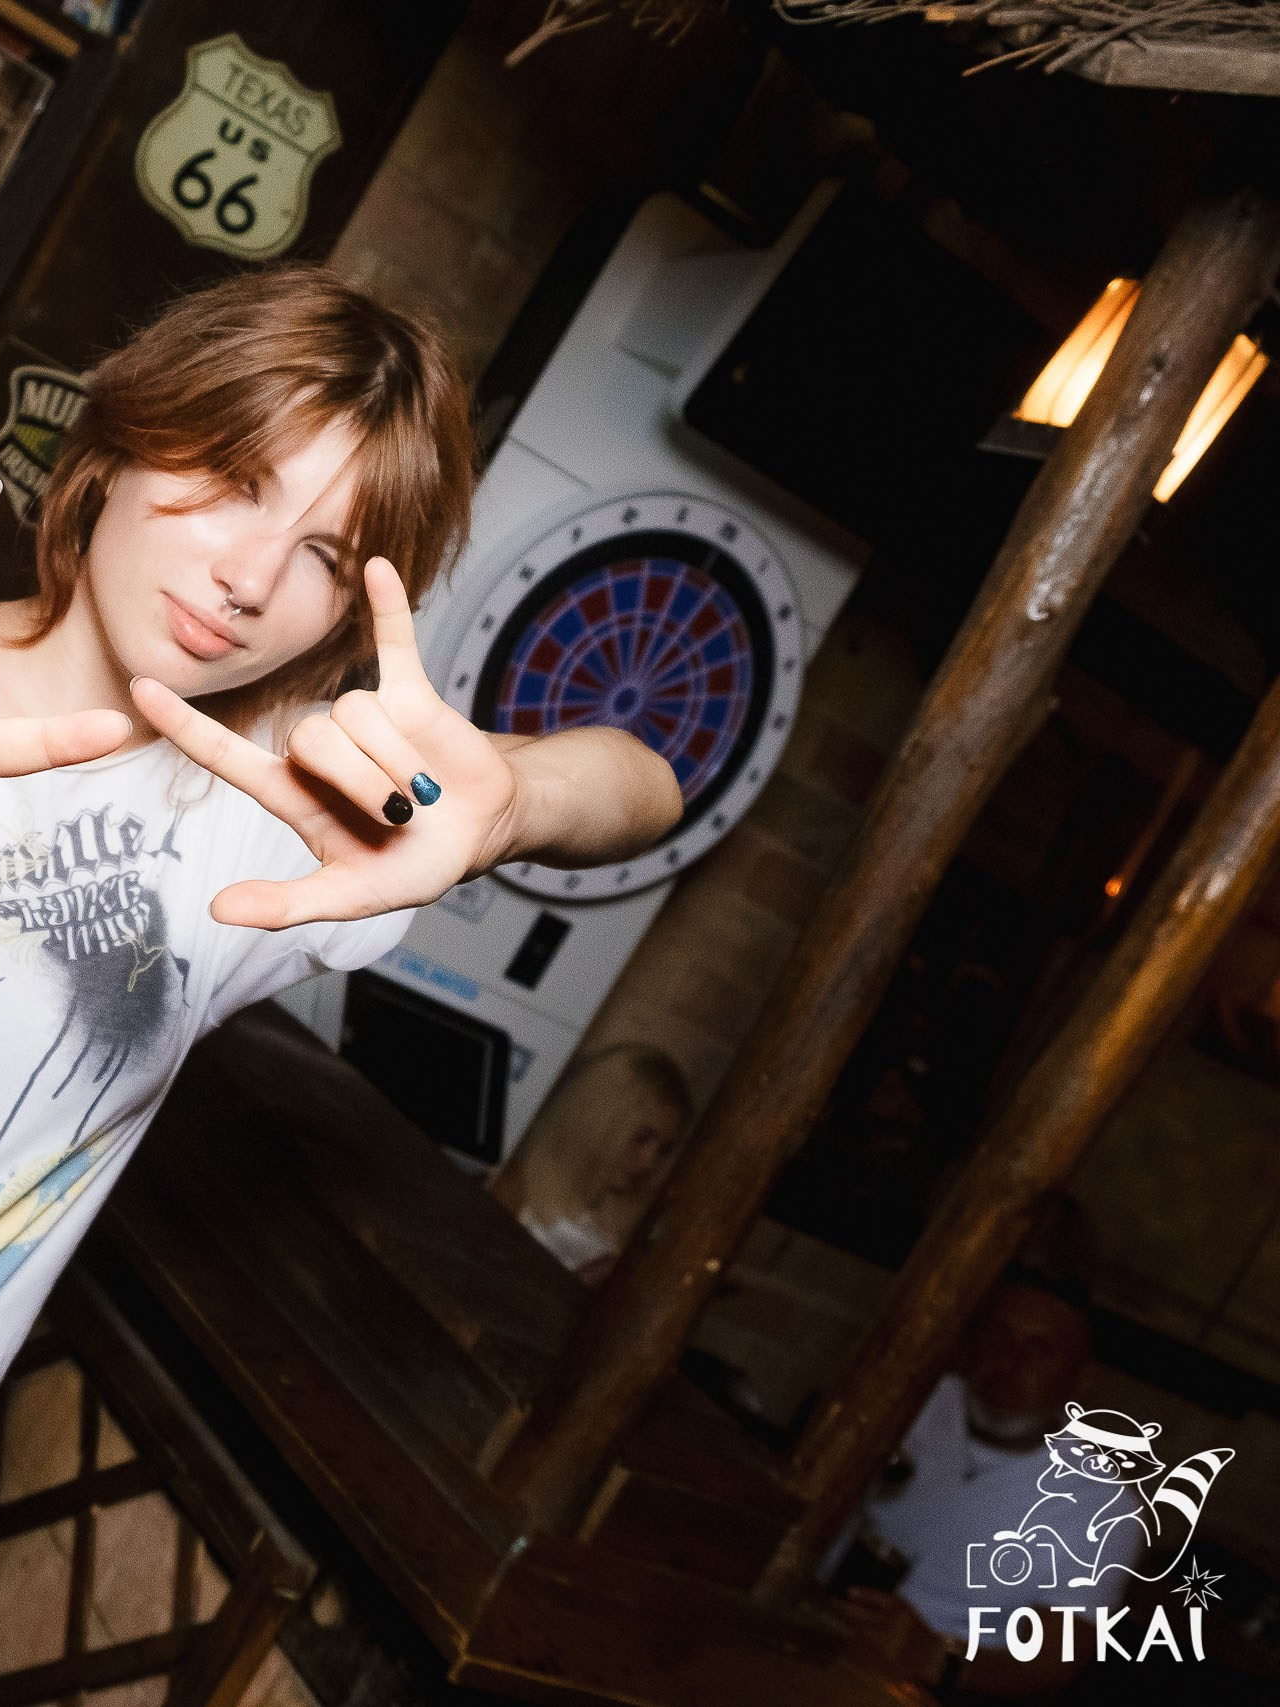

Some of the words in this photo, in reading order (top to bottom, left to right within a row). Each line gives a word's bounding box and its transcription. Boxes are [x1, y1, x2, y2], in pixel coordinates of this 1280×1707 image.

[222, 62, 312, 139] TEXAS
[219, 120, 271, 163] US
[172, 149, 261, 236] 66
